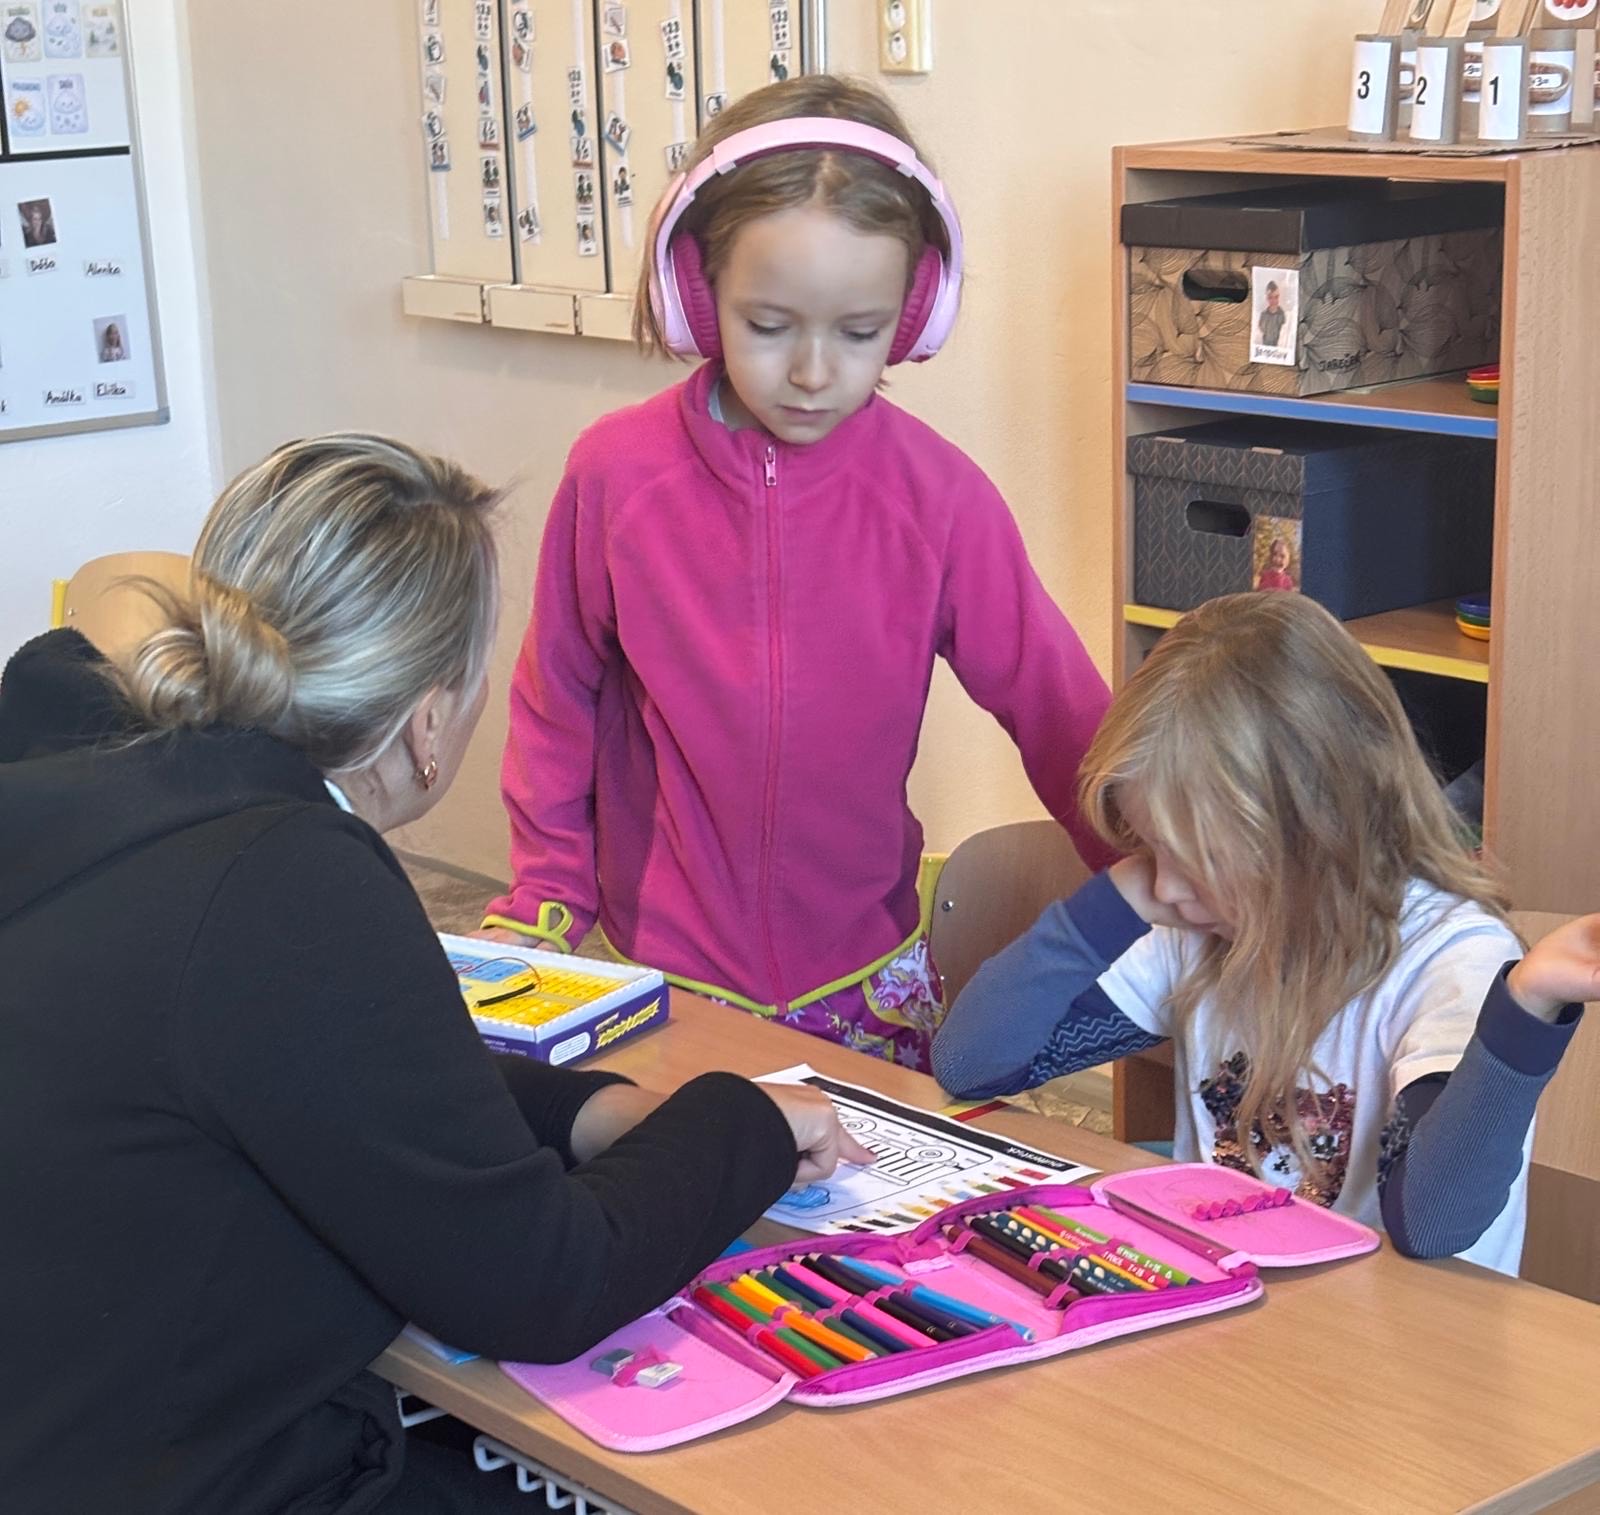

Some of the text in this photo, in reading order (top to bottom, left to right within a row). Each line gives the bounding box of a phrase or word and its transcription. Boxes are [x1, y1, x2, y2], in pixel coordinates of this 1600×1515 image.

[1357, 70, 1371, 100] 3
[1415, 76, 1428, 106] 2
[1488, 75, 1499, 105] 1
[1006, 1146, 1065, 1169] shutterstock
